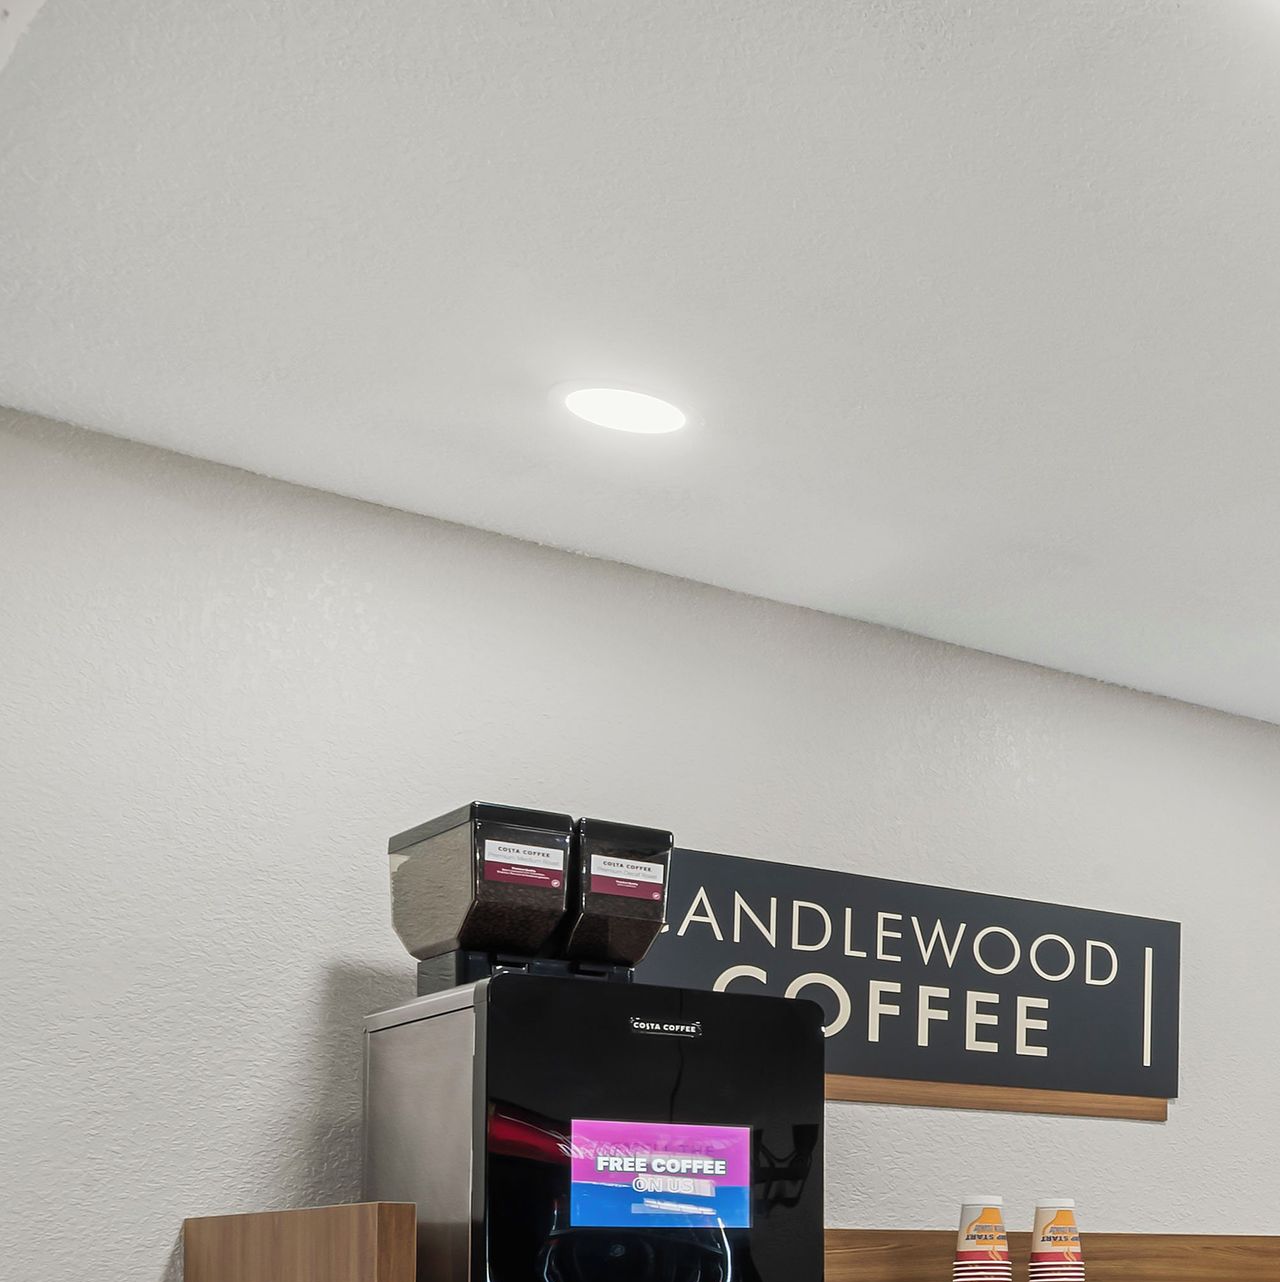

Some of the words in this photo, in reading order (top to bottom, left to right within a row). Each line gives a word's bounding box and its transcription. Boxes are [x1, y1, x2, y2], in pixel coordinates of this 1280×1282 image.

[498, 846, 520, 854] COSTA
[522, 850, 550, 858] COFFEE
[626, 864, 652, 872] COFFEE
[661, 886, 1118, 986] ANDLEWOOD
[633, 1021, 661, 1030] COSTA
[663, 1024, 696, 1033] COFFEE
[597, 1156, 648, 1173] FREE
[652, 1158, 727, 1175] COFFEE
[632, 1176, 662, 1193] ON
[669, 1177, 695, 1194] US
